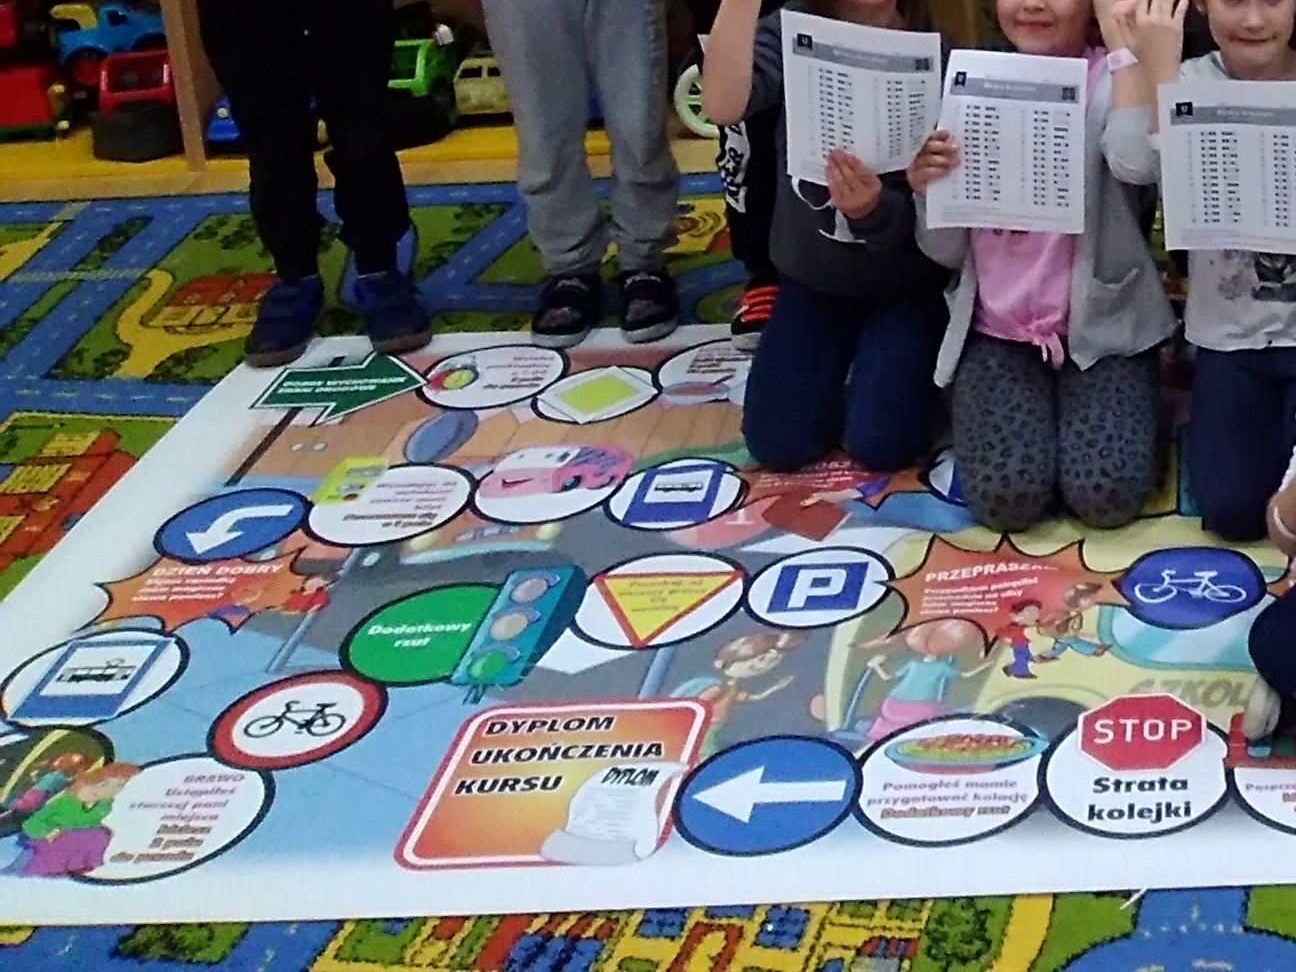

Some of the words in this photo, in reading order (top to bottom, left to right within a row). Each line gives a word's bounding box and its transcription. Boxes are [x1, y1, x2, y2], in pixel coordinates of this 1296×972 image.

[216, 563, 284, 576] DOBRY
[925, 561, 1058, 583] PRZEPRASZA
[788, 569, 847, 608] P
[367, 622, 472, 636] Dodatkowy
[394, 637, 431, 648] rzut
[484, 716, 614, 735] DYPLOM
[1093, 719, 1193, 744] STOP
[470, 742, 664, 764] UKOŃCZENIA
[183, 774, 245, 783] BRAWO
[454, 775, 563, 794] KURSU
[601, 767, 661, 786] DYPLOM
[883, 780, 960, 792] Pomogłeś
[965, 779, 1018, 789] mamie
[1092, 777, 1188, 794] Strata
[867, 794, 969, 807] przygotować
[973, 793, 1028, 804] kolację
[1088, 801, 1192, 824] kolejki
